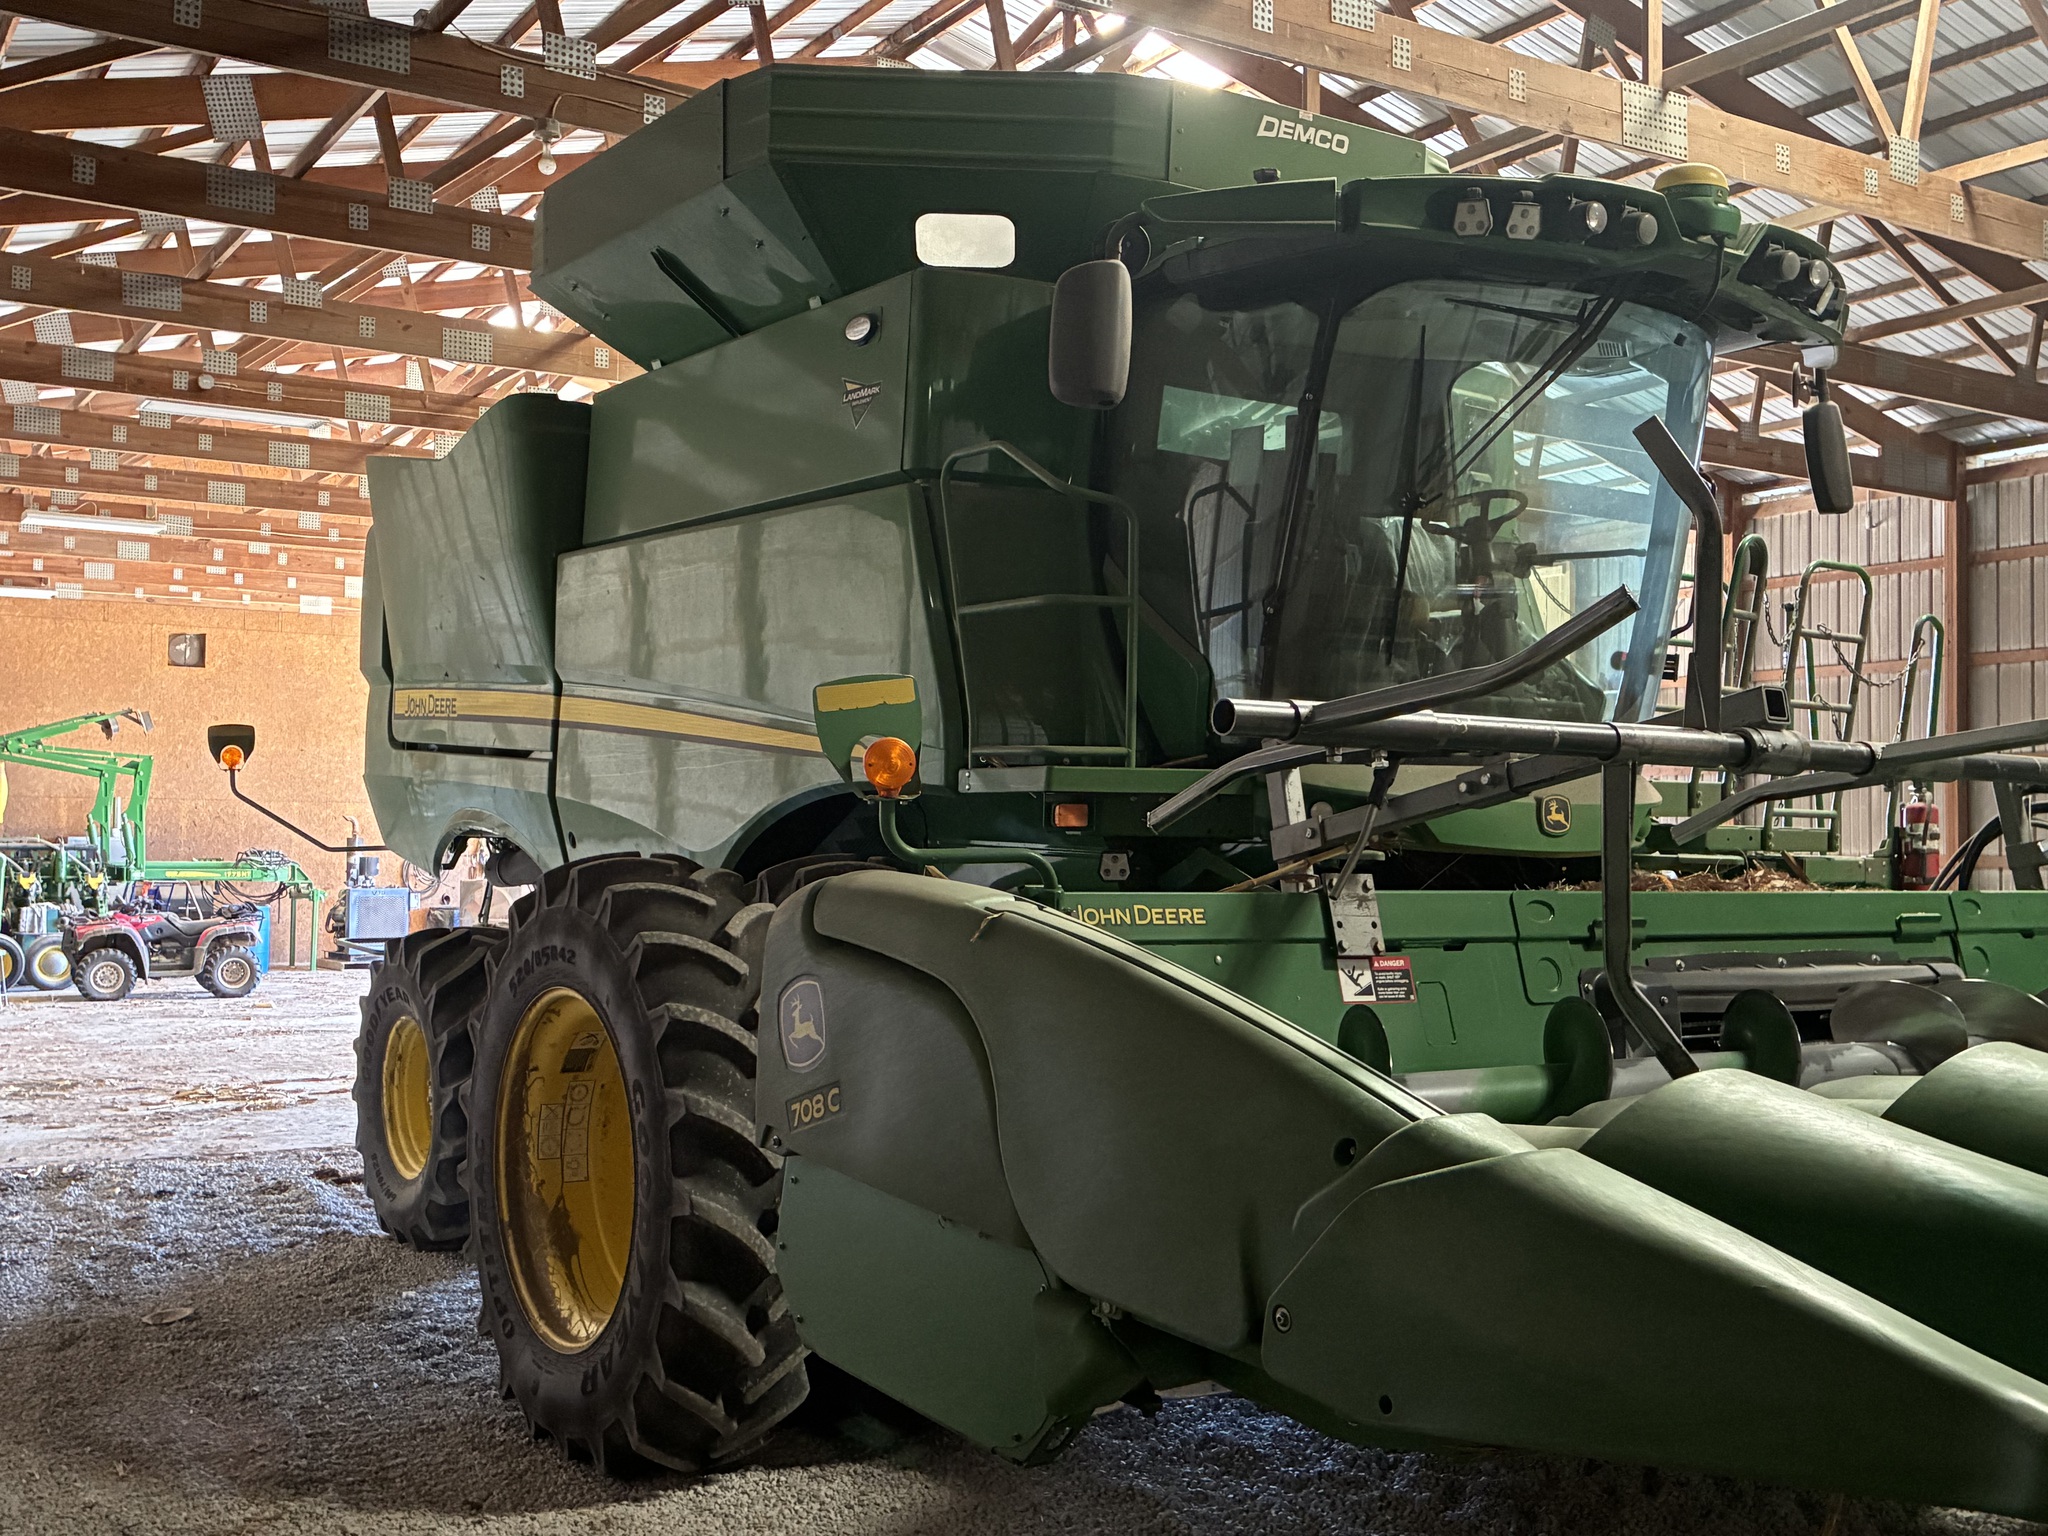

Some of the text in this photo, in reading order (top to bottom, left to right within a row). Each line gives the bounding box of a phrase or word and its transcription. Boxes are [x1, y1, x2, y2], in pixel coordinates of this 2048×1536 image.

[1256, 115, 1350, 155] DEMCO
[405, 694, 458, 715] JOHN DEERE
[1077, 904, 1207, 925] JOHN DEERE
[508, 945, 577, 998] 520/85R42
[361, 986, 411, 1081] GOODYEAR
